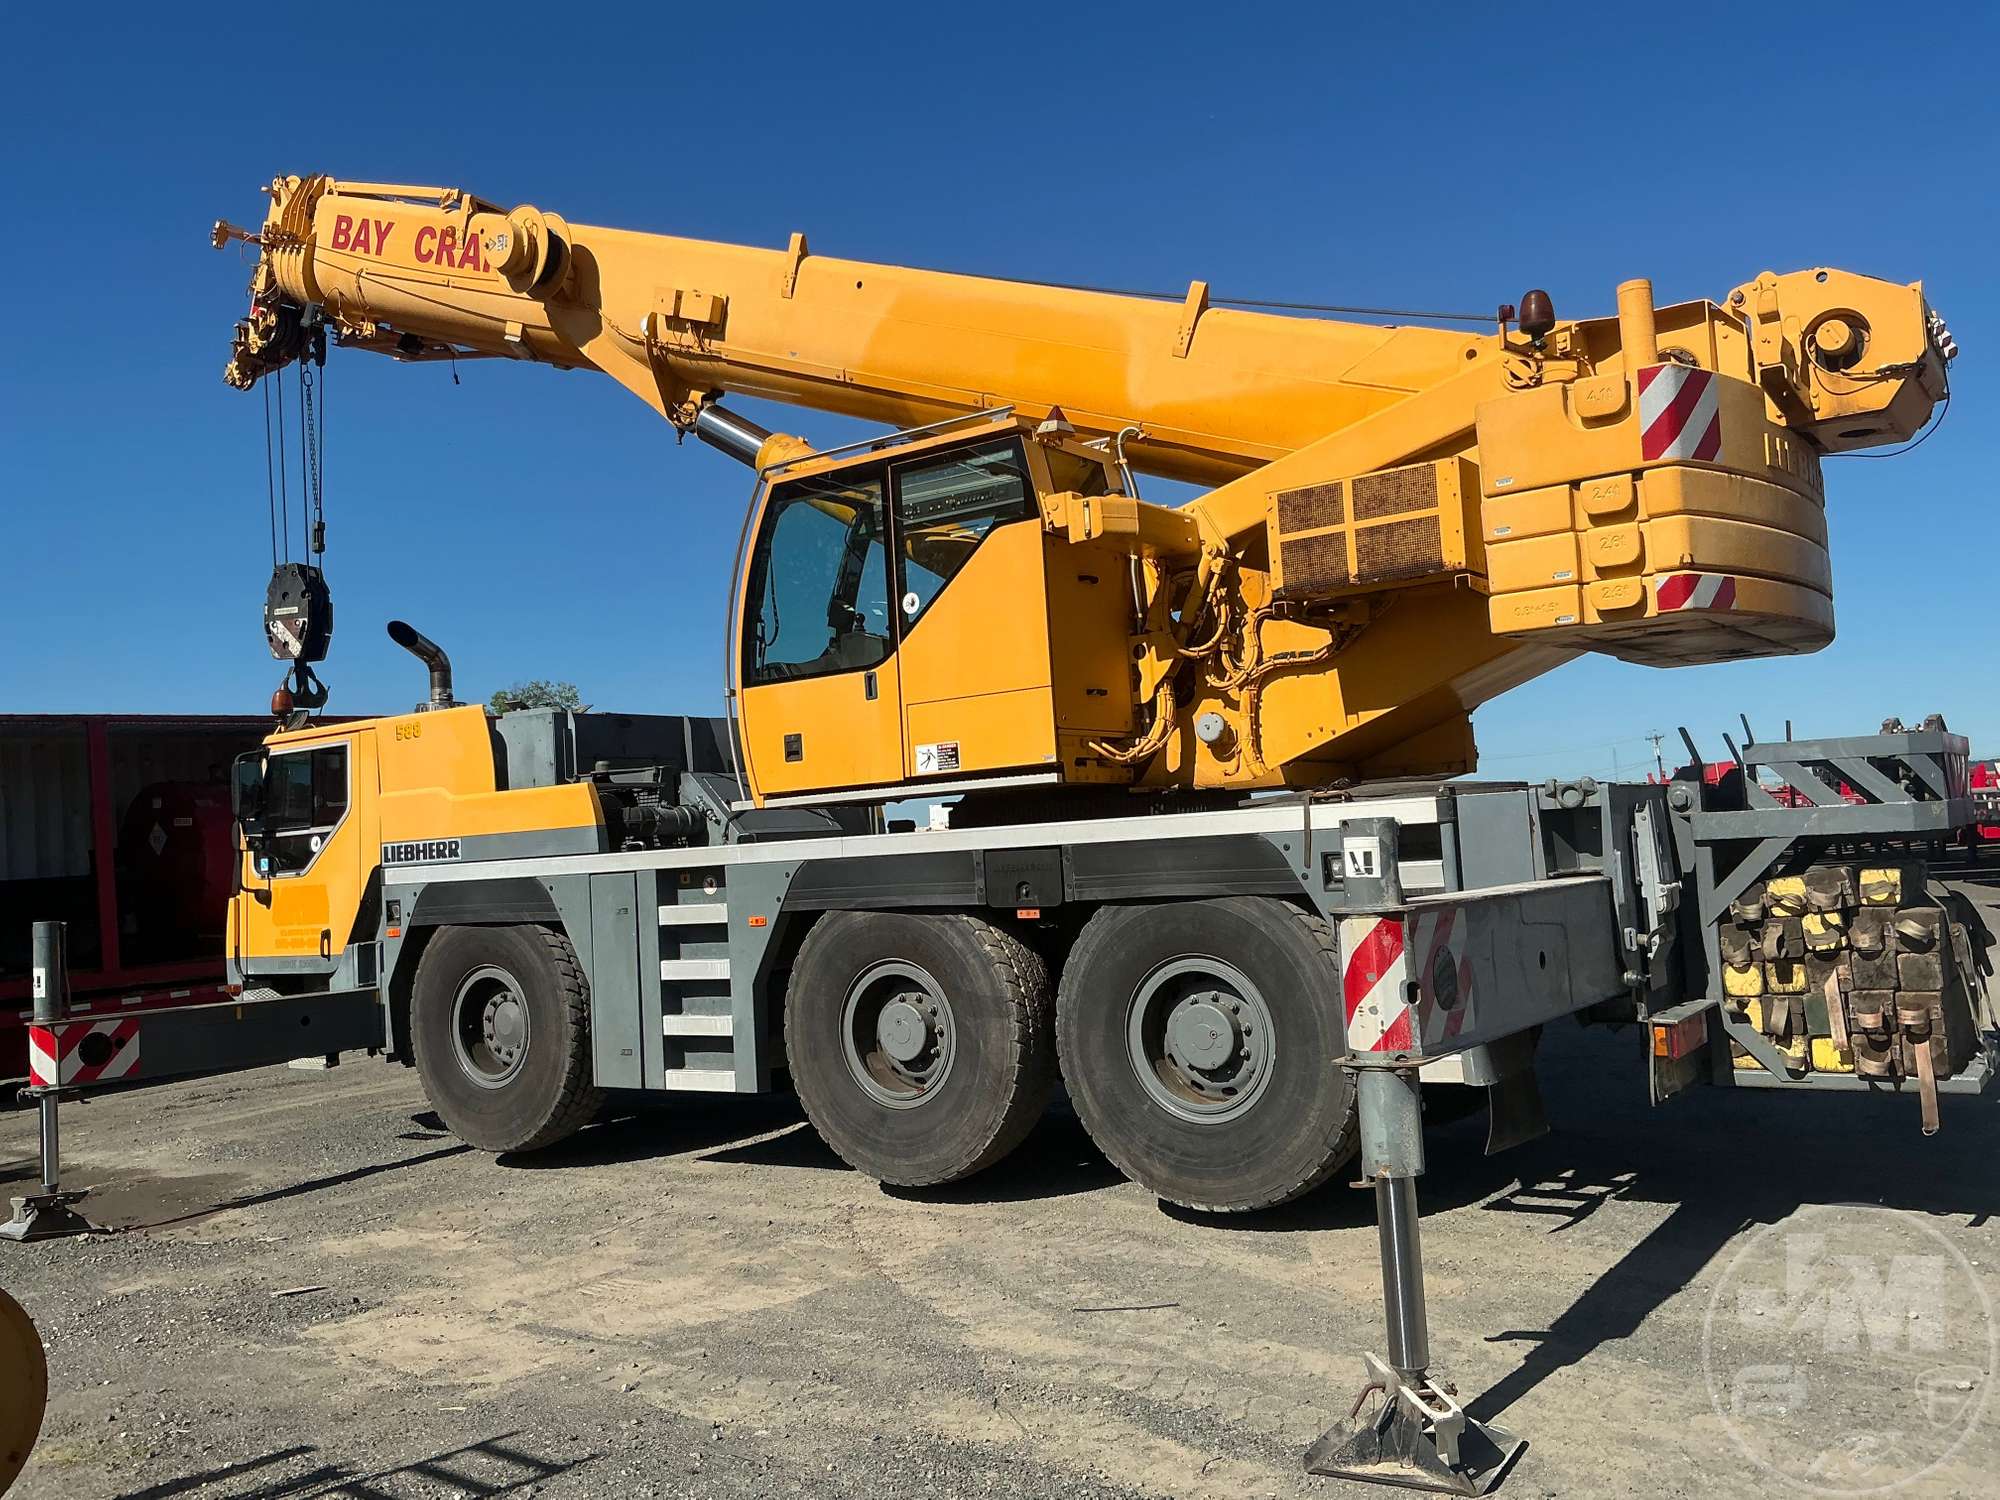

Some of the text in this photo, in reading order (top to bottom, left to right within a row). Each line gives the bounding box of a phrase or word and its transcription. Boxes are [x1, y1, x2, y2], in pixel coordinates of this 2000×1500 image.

[331, 214, 395, 257] BAY
[414, 225, 491, 273] CRA
[383, 840, 460, 863] LIEBHERR
